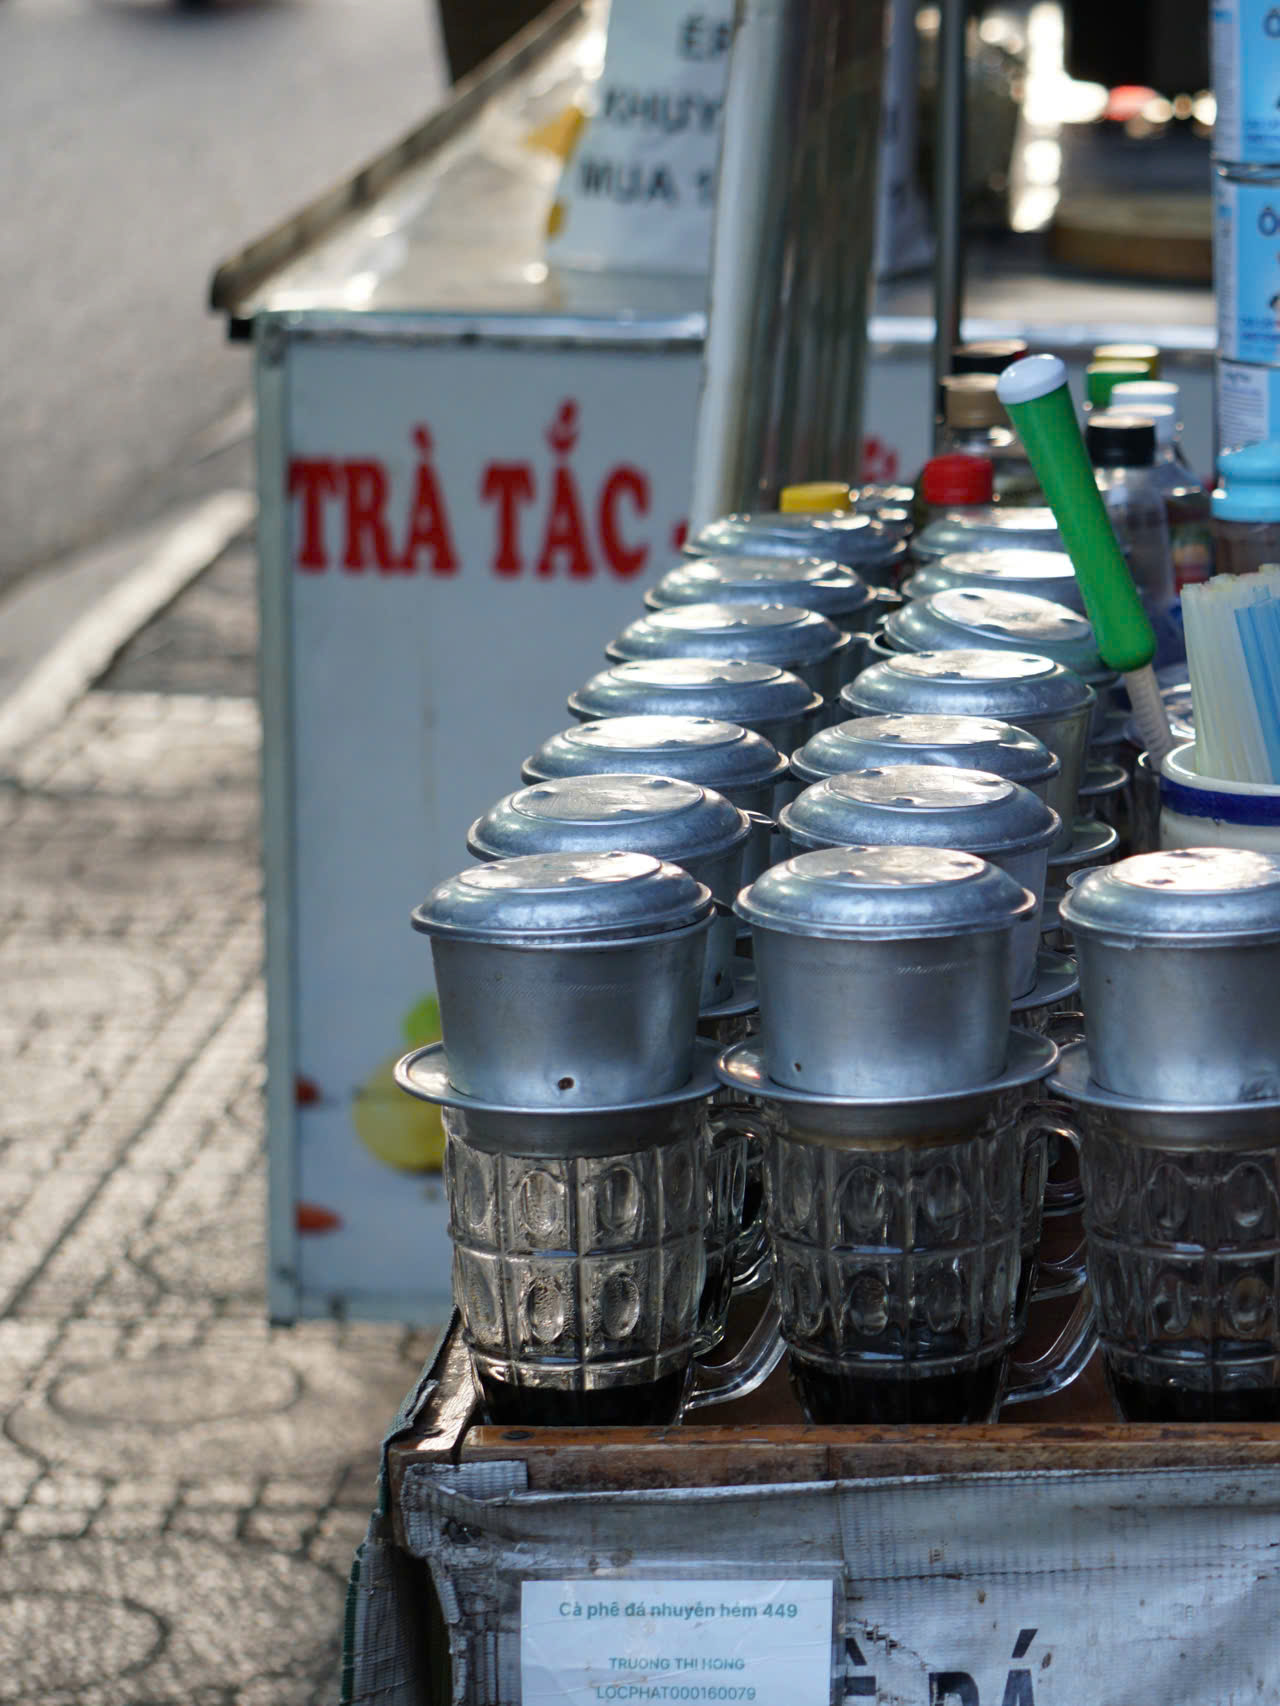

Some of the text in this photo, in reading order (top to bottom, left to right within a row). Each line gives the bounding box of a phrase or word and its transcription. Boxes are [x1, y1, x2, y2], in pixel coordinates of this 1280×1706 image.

[287, 423, 460, 576] TRÀ
[625, 1601, 646, 1617] đá
[762, 1603, 798, 1619] 449
[608, 1657, 670, 1671] TRUONG
[702, 1658, 746, 1671] HONG
[596, 1685, 757, 1702] LOCPHAT000160079
